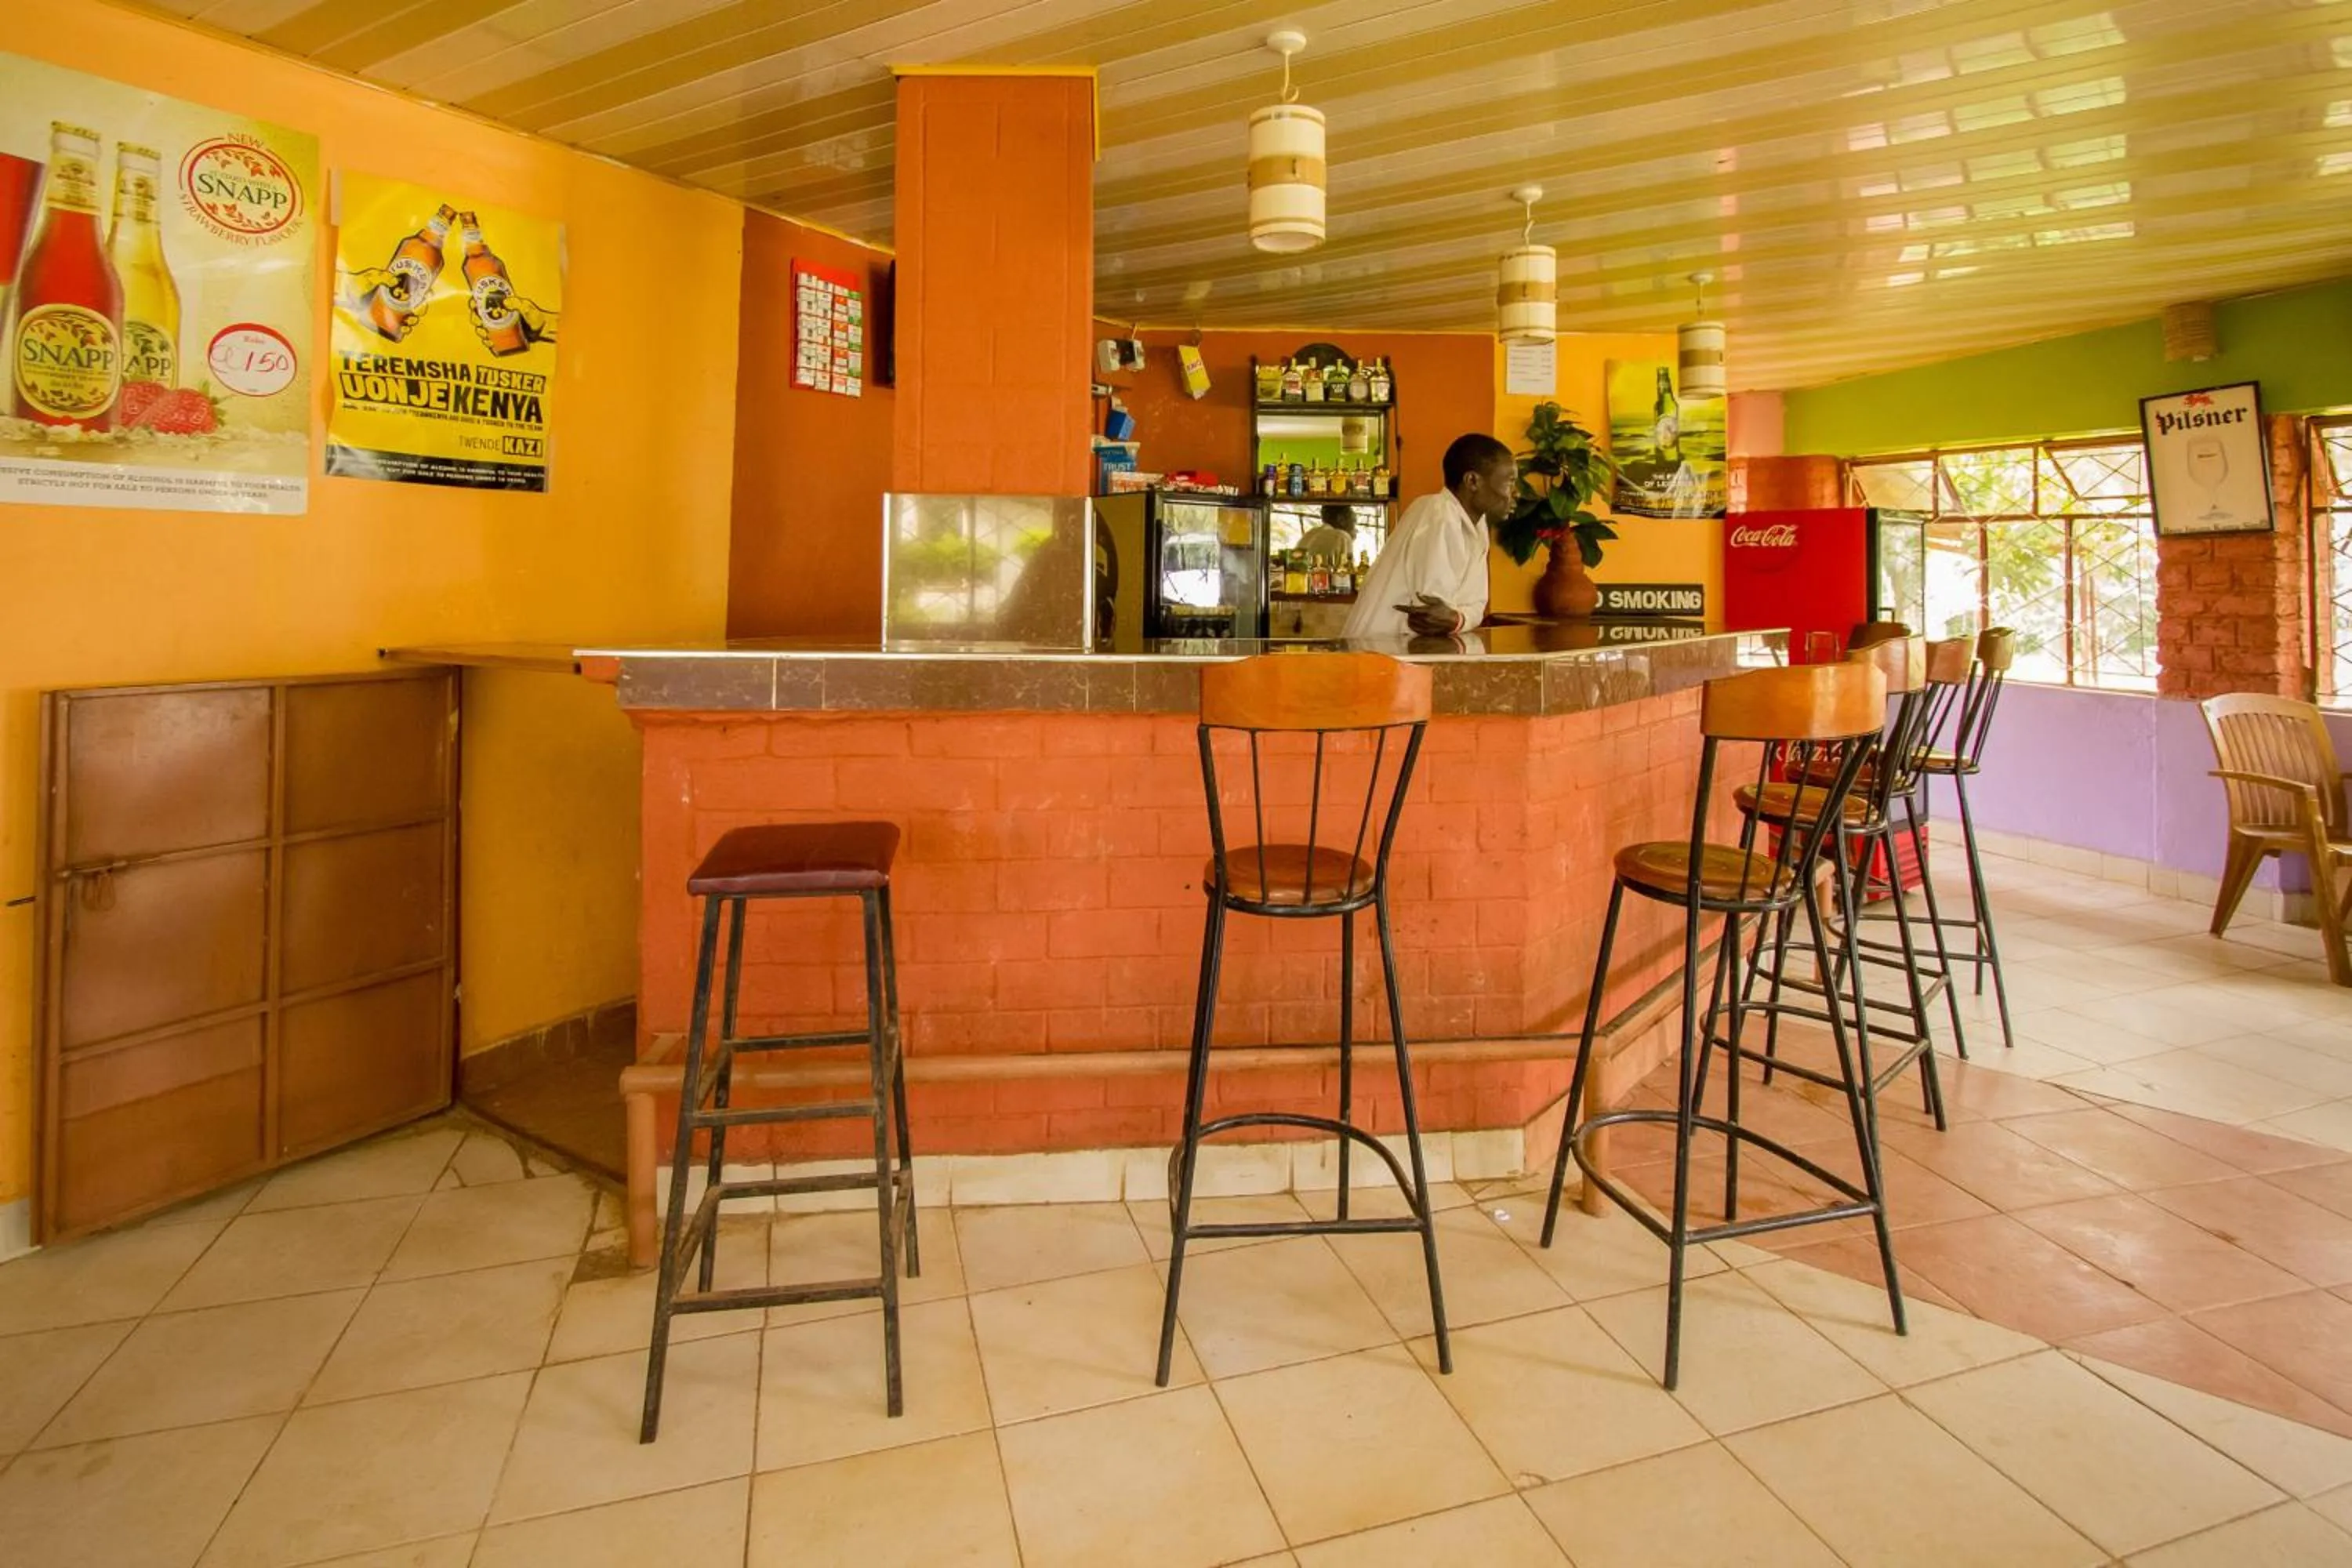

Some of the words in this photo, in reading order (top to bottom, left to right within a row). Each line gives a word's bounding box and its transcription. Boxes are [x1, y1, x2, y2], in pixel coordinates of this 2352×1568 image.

[227, 132, 264, 148] NEW
[198, 172, 288, 209] SNAPP
[179, 194, 250, 245] STRAWBERRY
[24, 338, 114, 371] SNAPP
[123, 354, 172, 377] APP
[339, 351, 472, 383] TEREMSHA
[477, 366, 545, 393] TUSKER
[341, 373, 448, 411] UONJE
[453, 383, 543, 424] KENYA
[2155, 407, 2248, 436] Pilsner
[459, 435, 500, 452] TWENDE
[503, 436, 542, 457] KAZI
[1730, 524, 1799, 548] Coca-Cola
[1608, 590, 1702, 610] SMOKING
